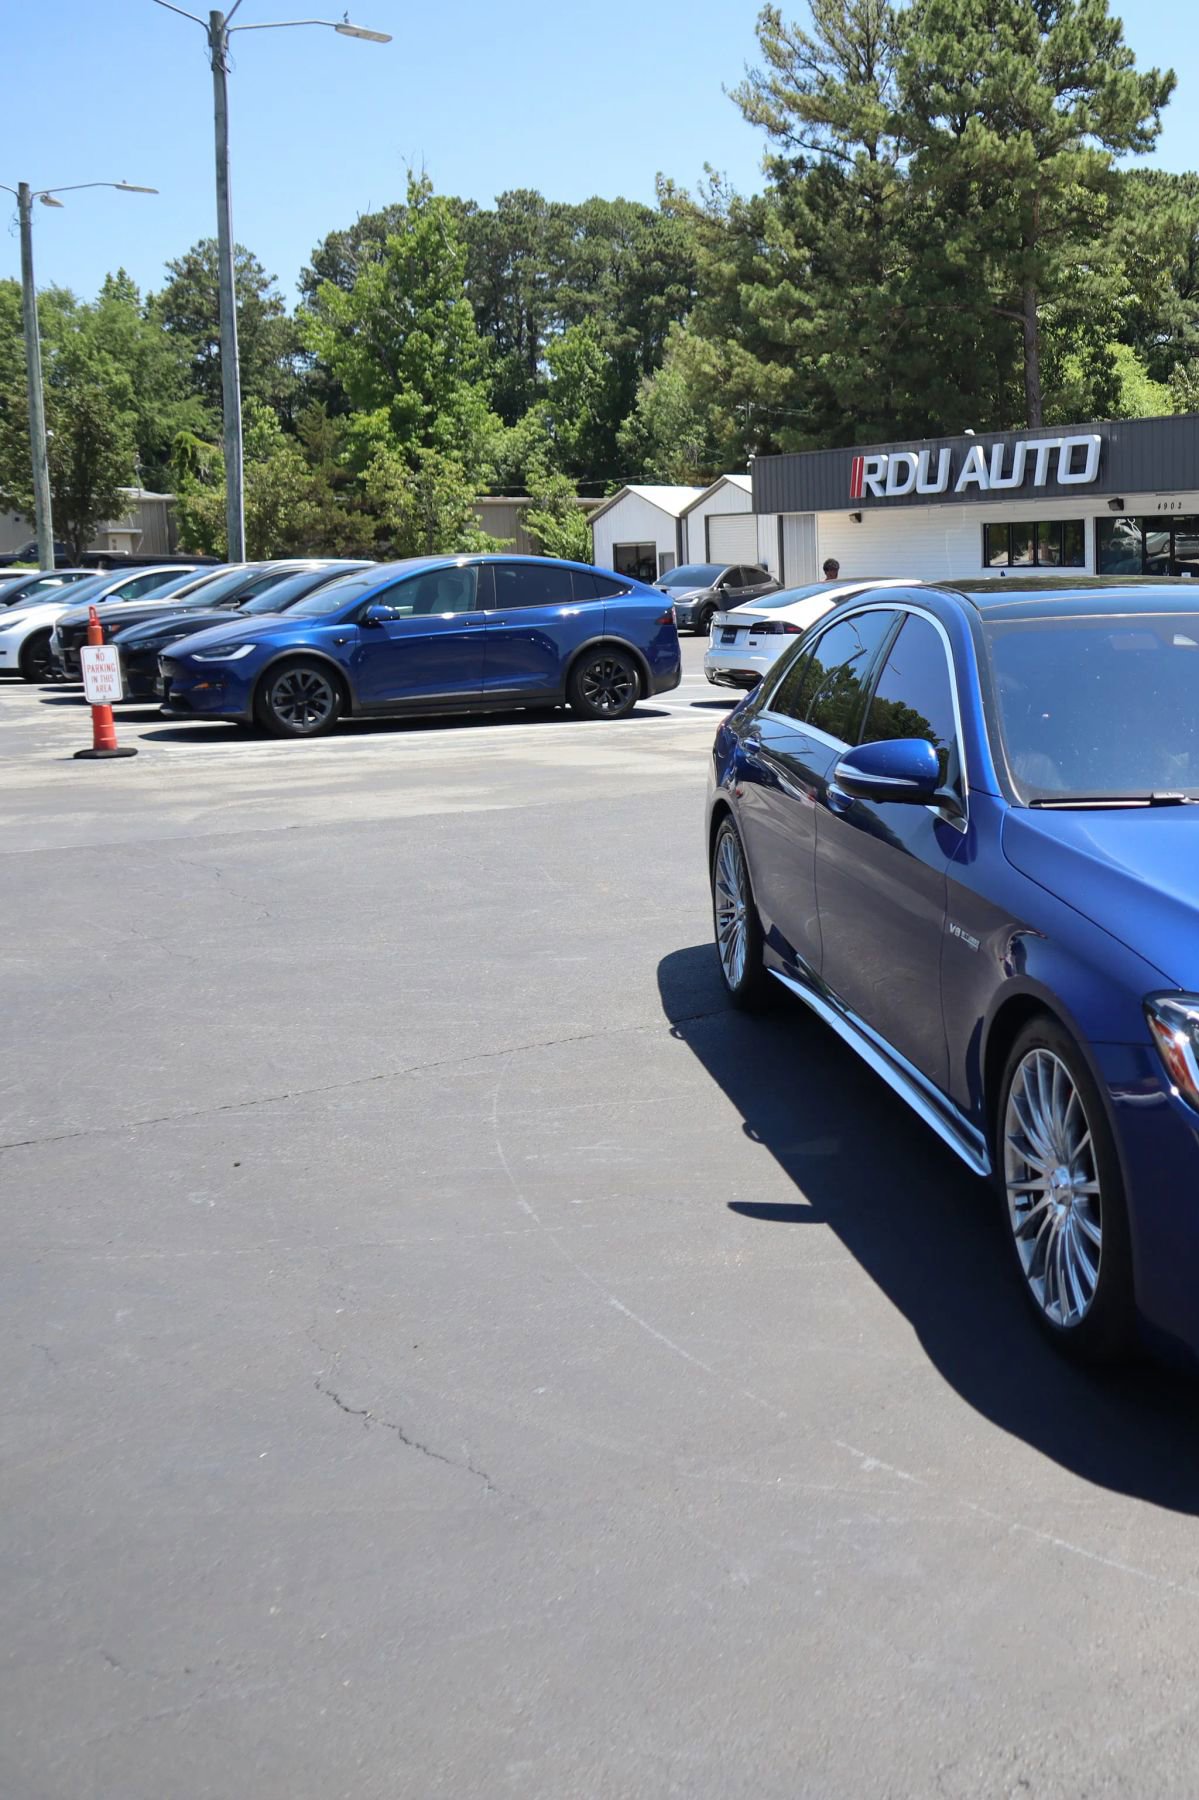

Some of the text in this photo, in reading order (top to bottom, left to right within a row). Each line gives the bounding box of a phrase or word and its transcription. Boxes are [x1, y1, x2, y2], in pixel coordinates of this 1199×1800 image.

[850, 434, 1101, 498] RDU AUTO
[95, 652, 105, 661] NO
[86, 663, 116, 673] PARKING
[91, 674, 113, 683] IN THIS
[95, 684, 112, 693] AREA
